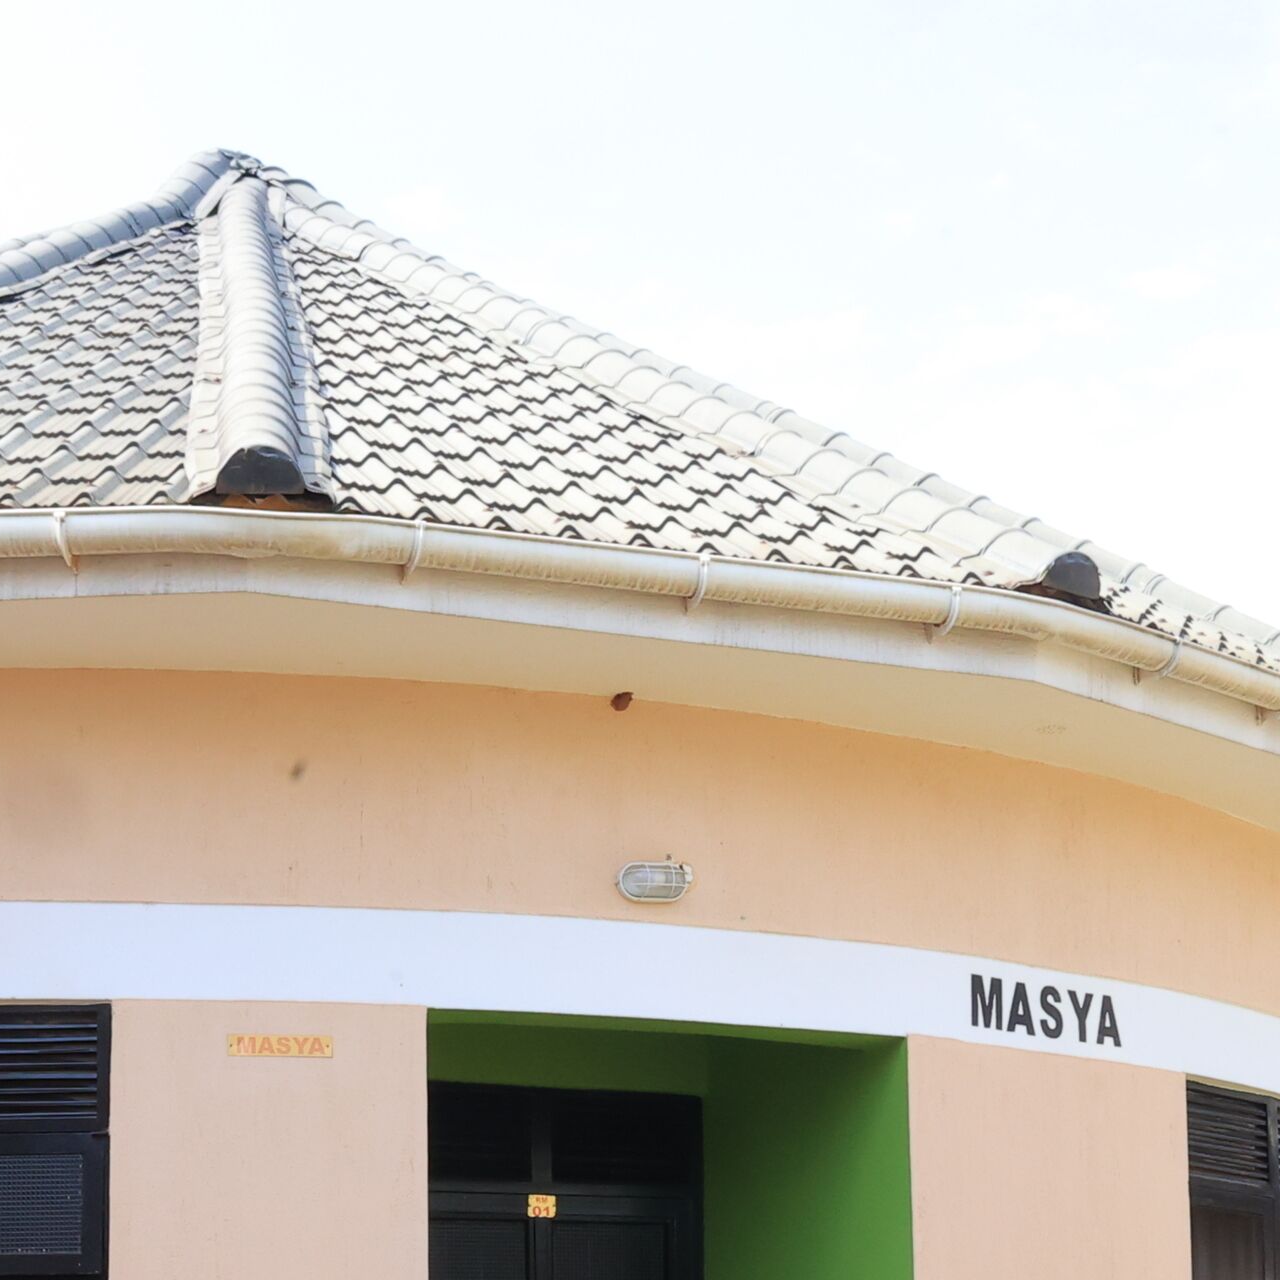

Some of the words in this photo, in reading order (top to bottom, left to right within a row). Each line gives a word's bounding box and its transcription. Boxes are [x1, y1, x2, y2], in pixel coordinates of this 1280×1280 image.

[971, 973, 1122, 1048] MASYA
[236, 1036, 325, 1055] MASYA
[532, 1206, 550, 1217] 01
